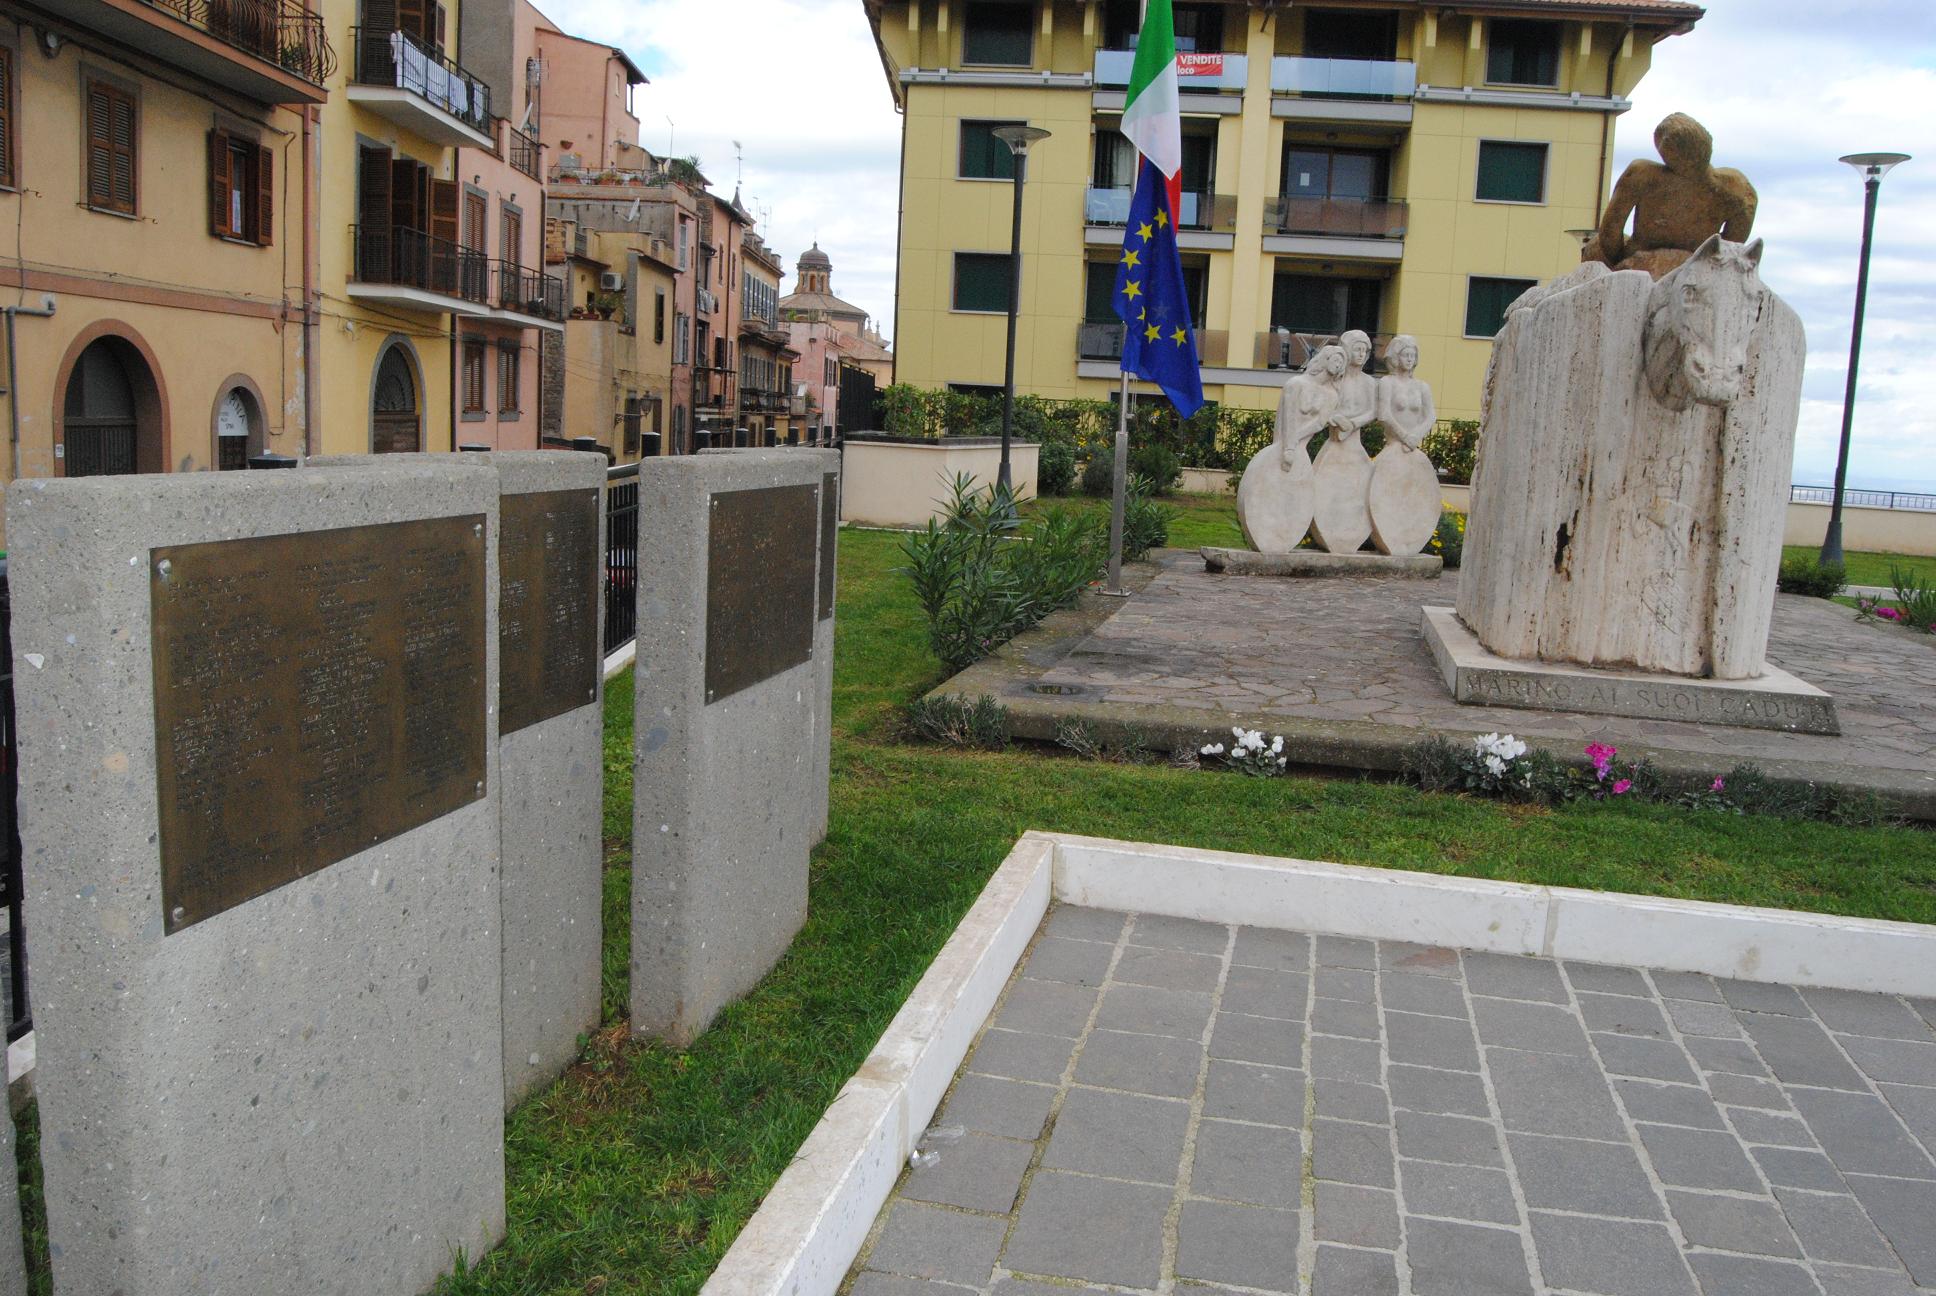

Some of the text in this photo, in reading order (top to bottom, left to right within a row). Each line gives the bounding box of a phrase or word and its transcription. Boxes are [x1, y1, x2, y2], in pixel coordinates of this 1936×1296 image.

[1181, 55, 1222, 65] VENDITE
[1177, 65, 1195, 74] loco
[1465, 674, 1572, 701] MARINO
[1591, 685, 1618, 705] AI
[1636, 689, 1700, 712] SUOI
